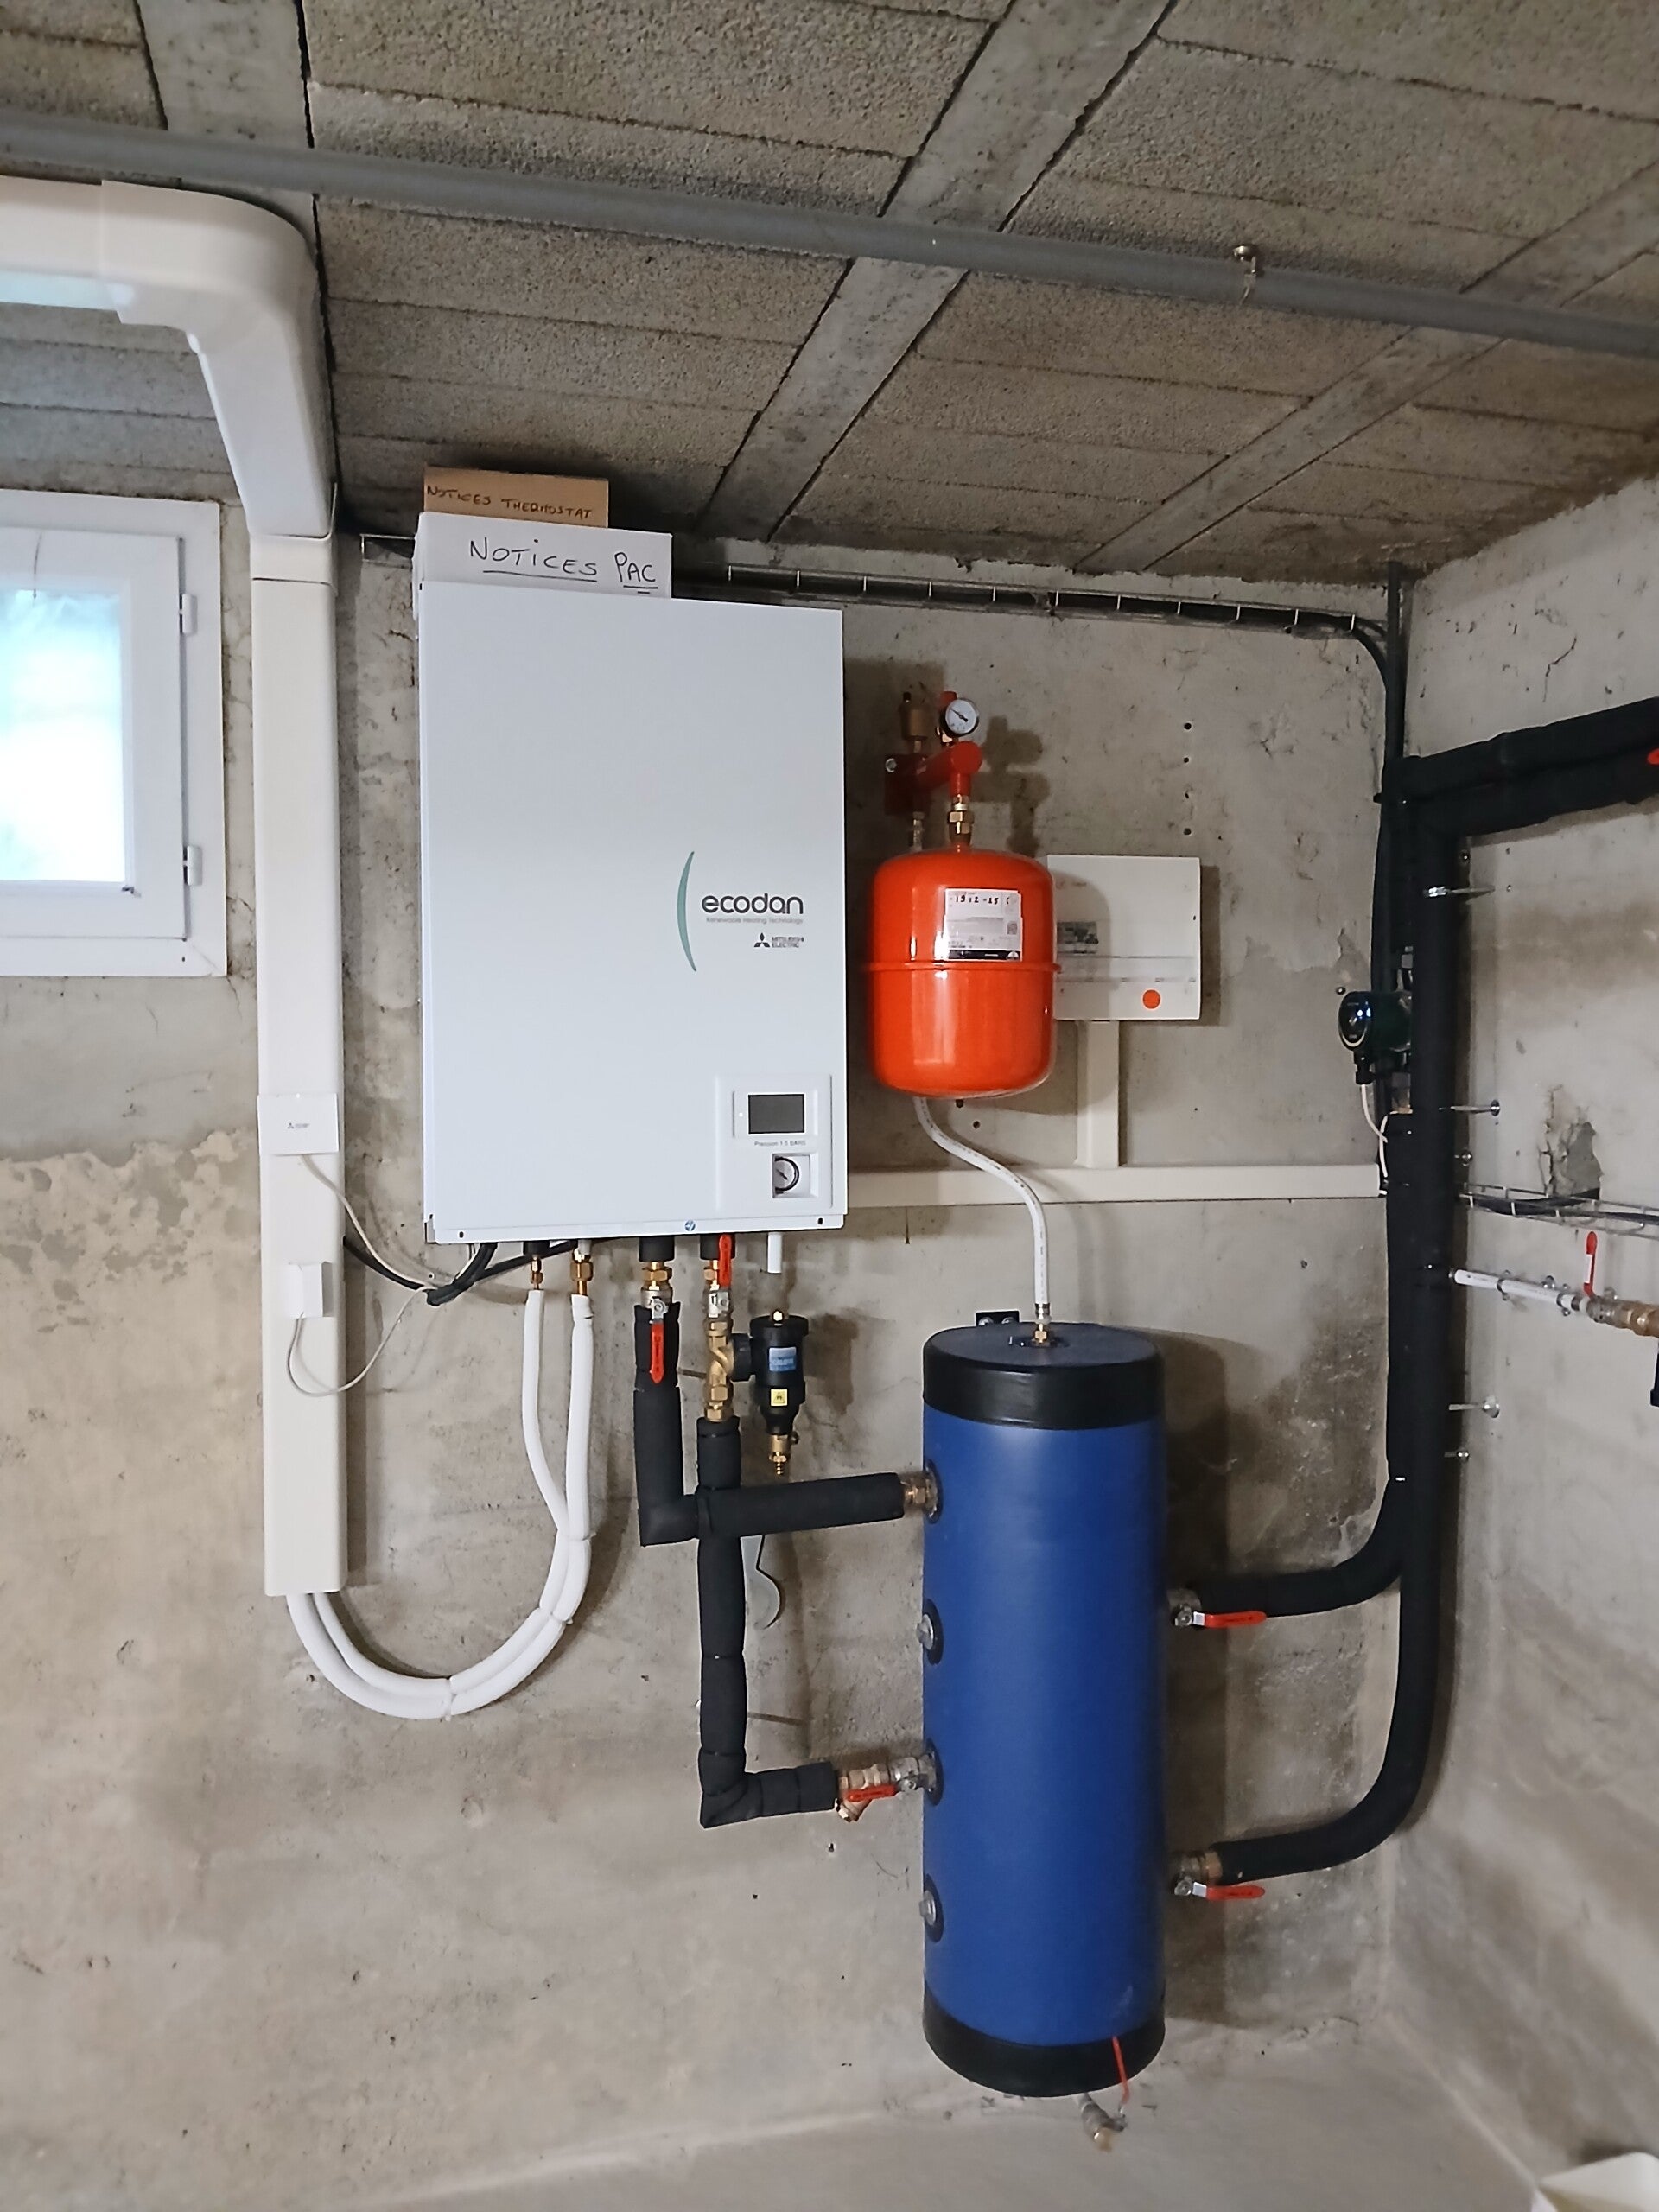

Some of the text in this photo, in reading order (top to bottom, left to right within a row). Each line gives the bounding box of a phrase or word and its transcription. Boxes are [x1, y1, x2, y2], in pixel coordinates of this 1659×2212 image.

[427, 485, 593, 519] NOTICES THERMOSTAT
[613, 552, 656, 583] PAC
[702, 893, 804, 914] ecodan
